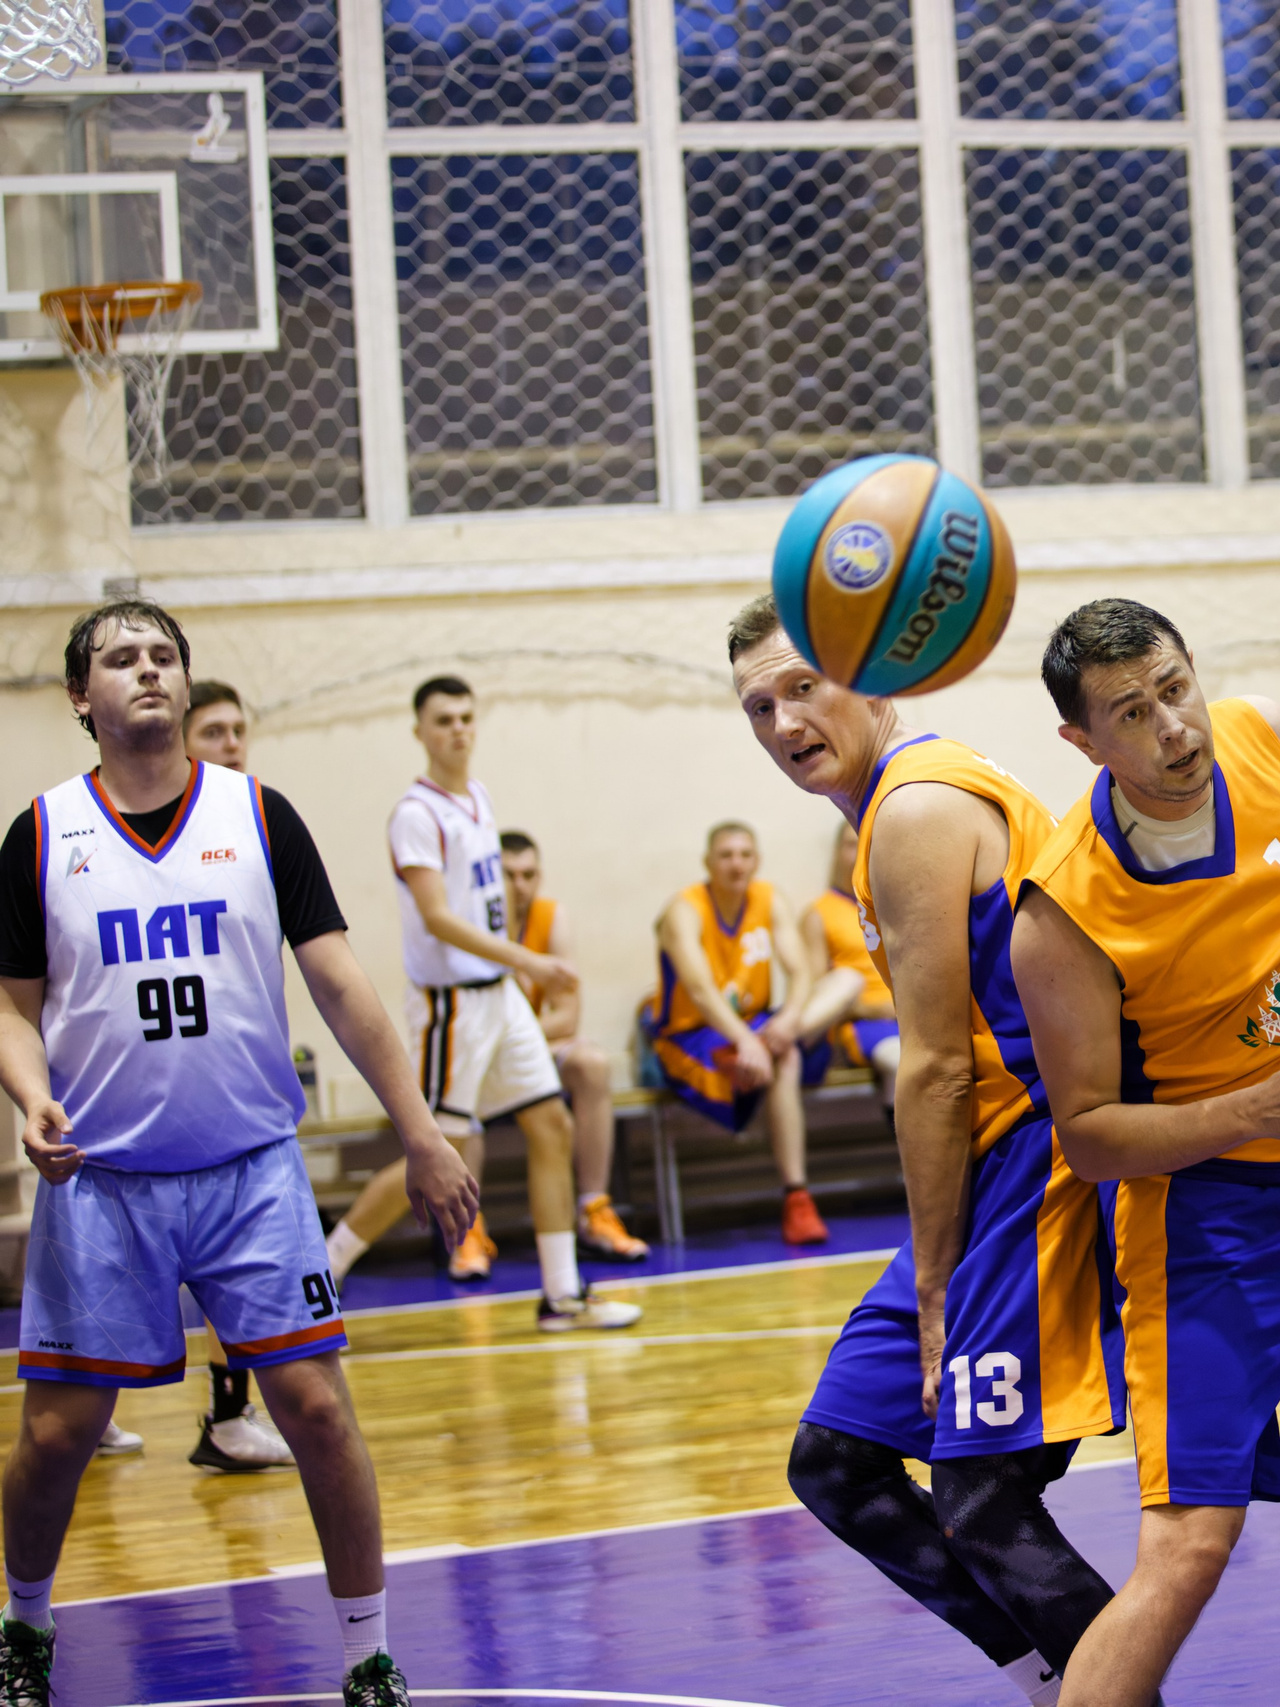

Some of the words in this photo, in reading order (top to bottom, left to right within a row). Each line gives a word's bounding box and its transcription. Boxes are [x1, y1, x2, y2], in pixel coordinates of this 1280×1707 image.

[885, 512, 977, 662] Wilson
[62, 827, 95, 840] MAXX
[97, 900, 227, 966] ПАТ
[137, 975, 208, 1042] 99
[39, 1340, 73, 1350] MAXX
[948, 1351, 1024, 1430] 13
